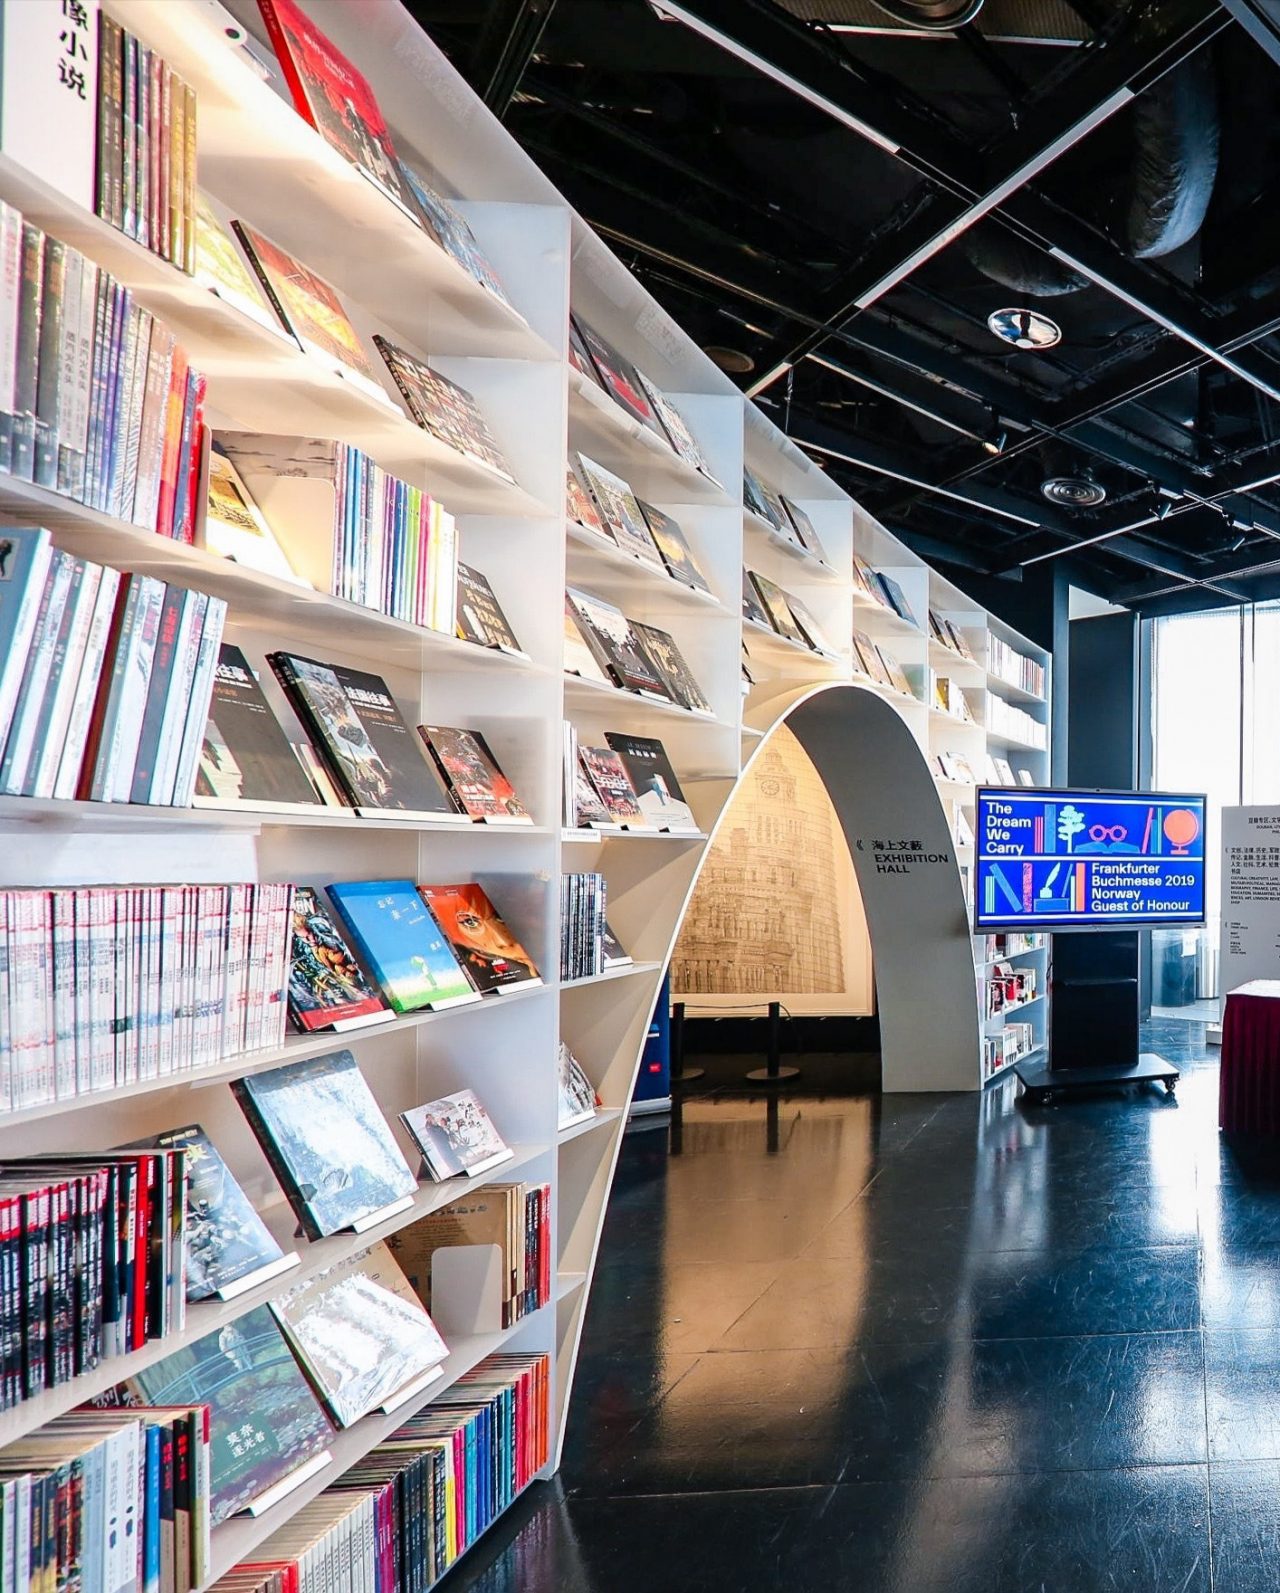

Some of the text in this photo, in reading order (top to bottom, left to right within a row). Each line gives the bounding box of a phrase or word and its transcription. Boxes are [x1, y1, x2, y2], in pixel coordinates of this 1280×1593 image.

[215, 663, 248, 681] 往事
[986, 802, 1012, 814] The
[987, 815, 1032, 828] Dream
[986, 828, 1011, 841] We
[986, 841, 1024, 856] Carry
[874, 854, 948, 863] EXHIBITION
[877, 865, 910, 873] HALL
[1091, 863, 1160, 875] Frankfurter
[1091, 875, 1195, 887] Buchmesse 2019
[1091, 888, 1141, 900] Norway
[1091, 900, 1190, 912] Guest of Honour
[226, 1423, 254, 1446] 莫奈
